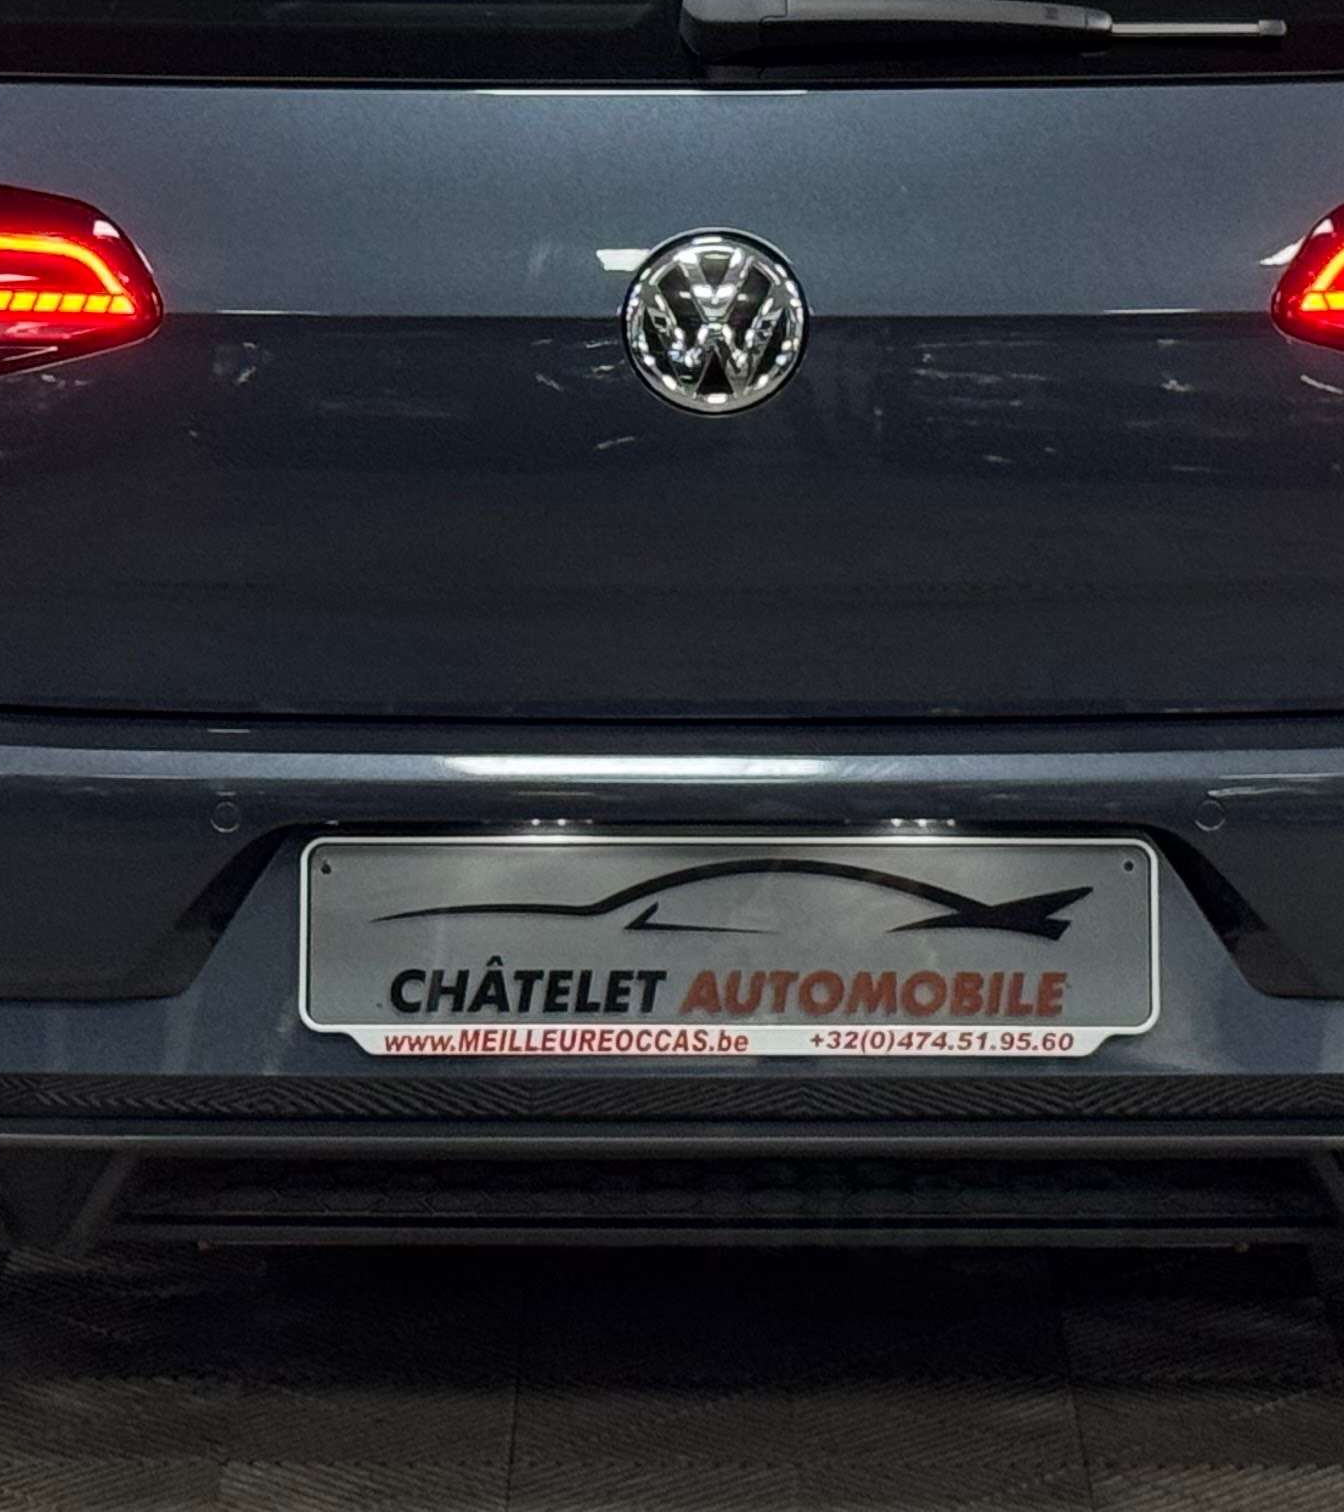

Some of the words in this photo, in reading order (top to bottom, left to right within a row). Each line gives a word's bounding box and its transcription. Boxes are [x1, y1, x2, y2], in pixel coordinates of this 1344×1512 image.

[389, 955, 667, 1014] CHÂTELET
[678, 970, 1068, 1018] AUTOMOBILE
[384, 1029, 749, 1053] www.MEILLEUREOCCAS.be
[810, 1031, 1075, 1056] +32(0)474.51.95.60
